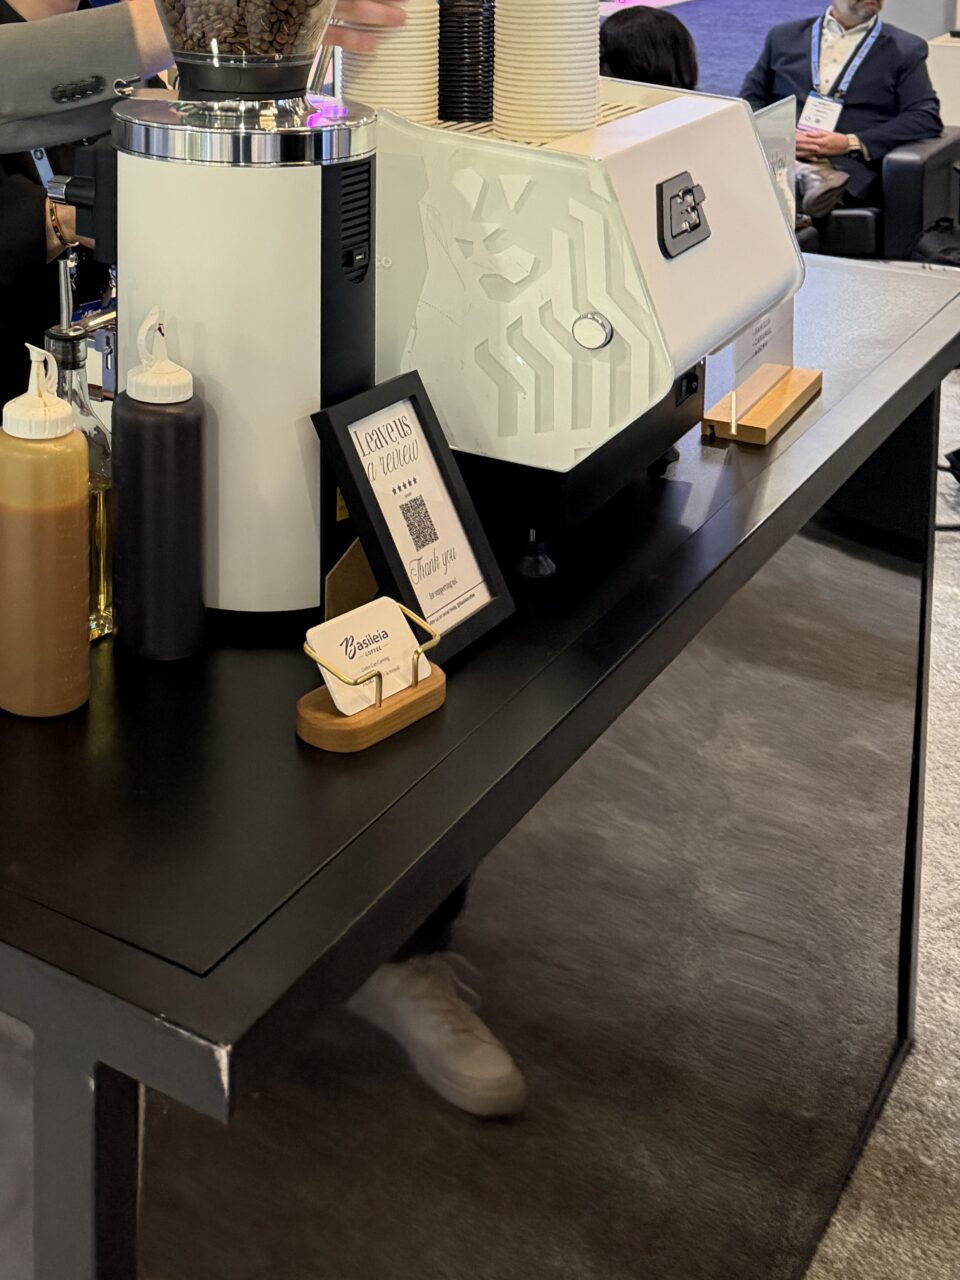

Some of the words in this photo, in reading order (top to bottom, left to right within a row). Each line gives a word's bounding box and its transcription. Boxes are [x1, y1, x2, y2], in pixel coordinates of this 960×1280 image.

[354, 420, 398, 458] Leave
[395, 415, 413, 440] us
[367, 460, 377, 483] a
[379, 439, 420, 477] review
[409, 547, 440, 585] Thank
[442, 546, 457, 576] you
[339, 628, 390, 661] Basileia
